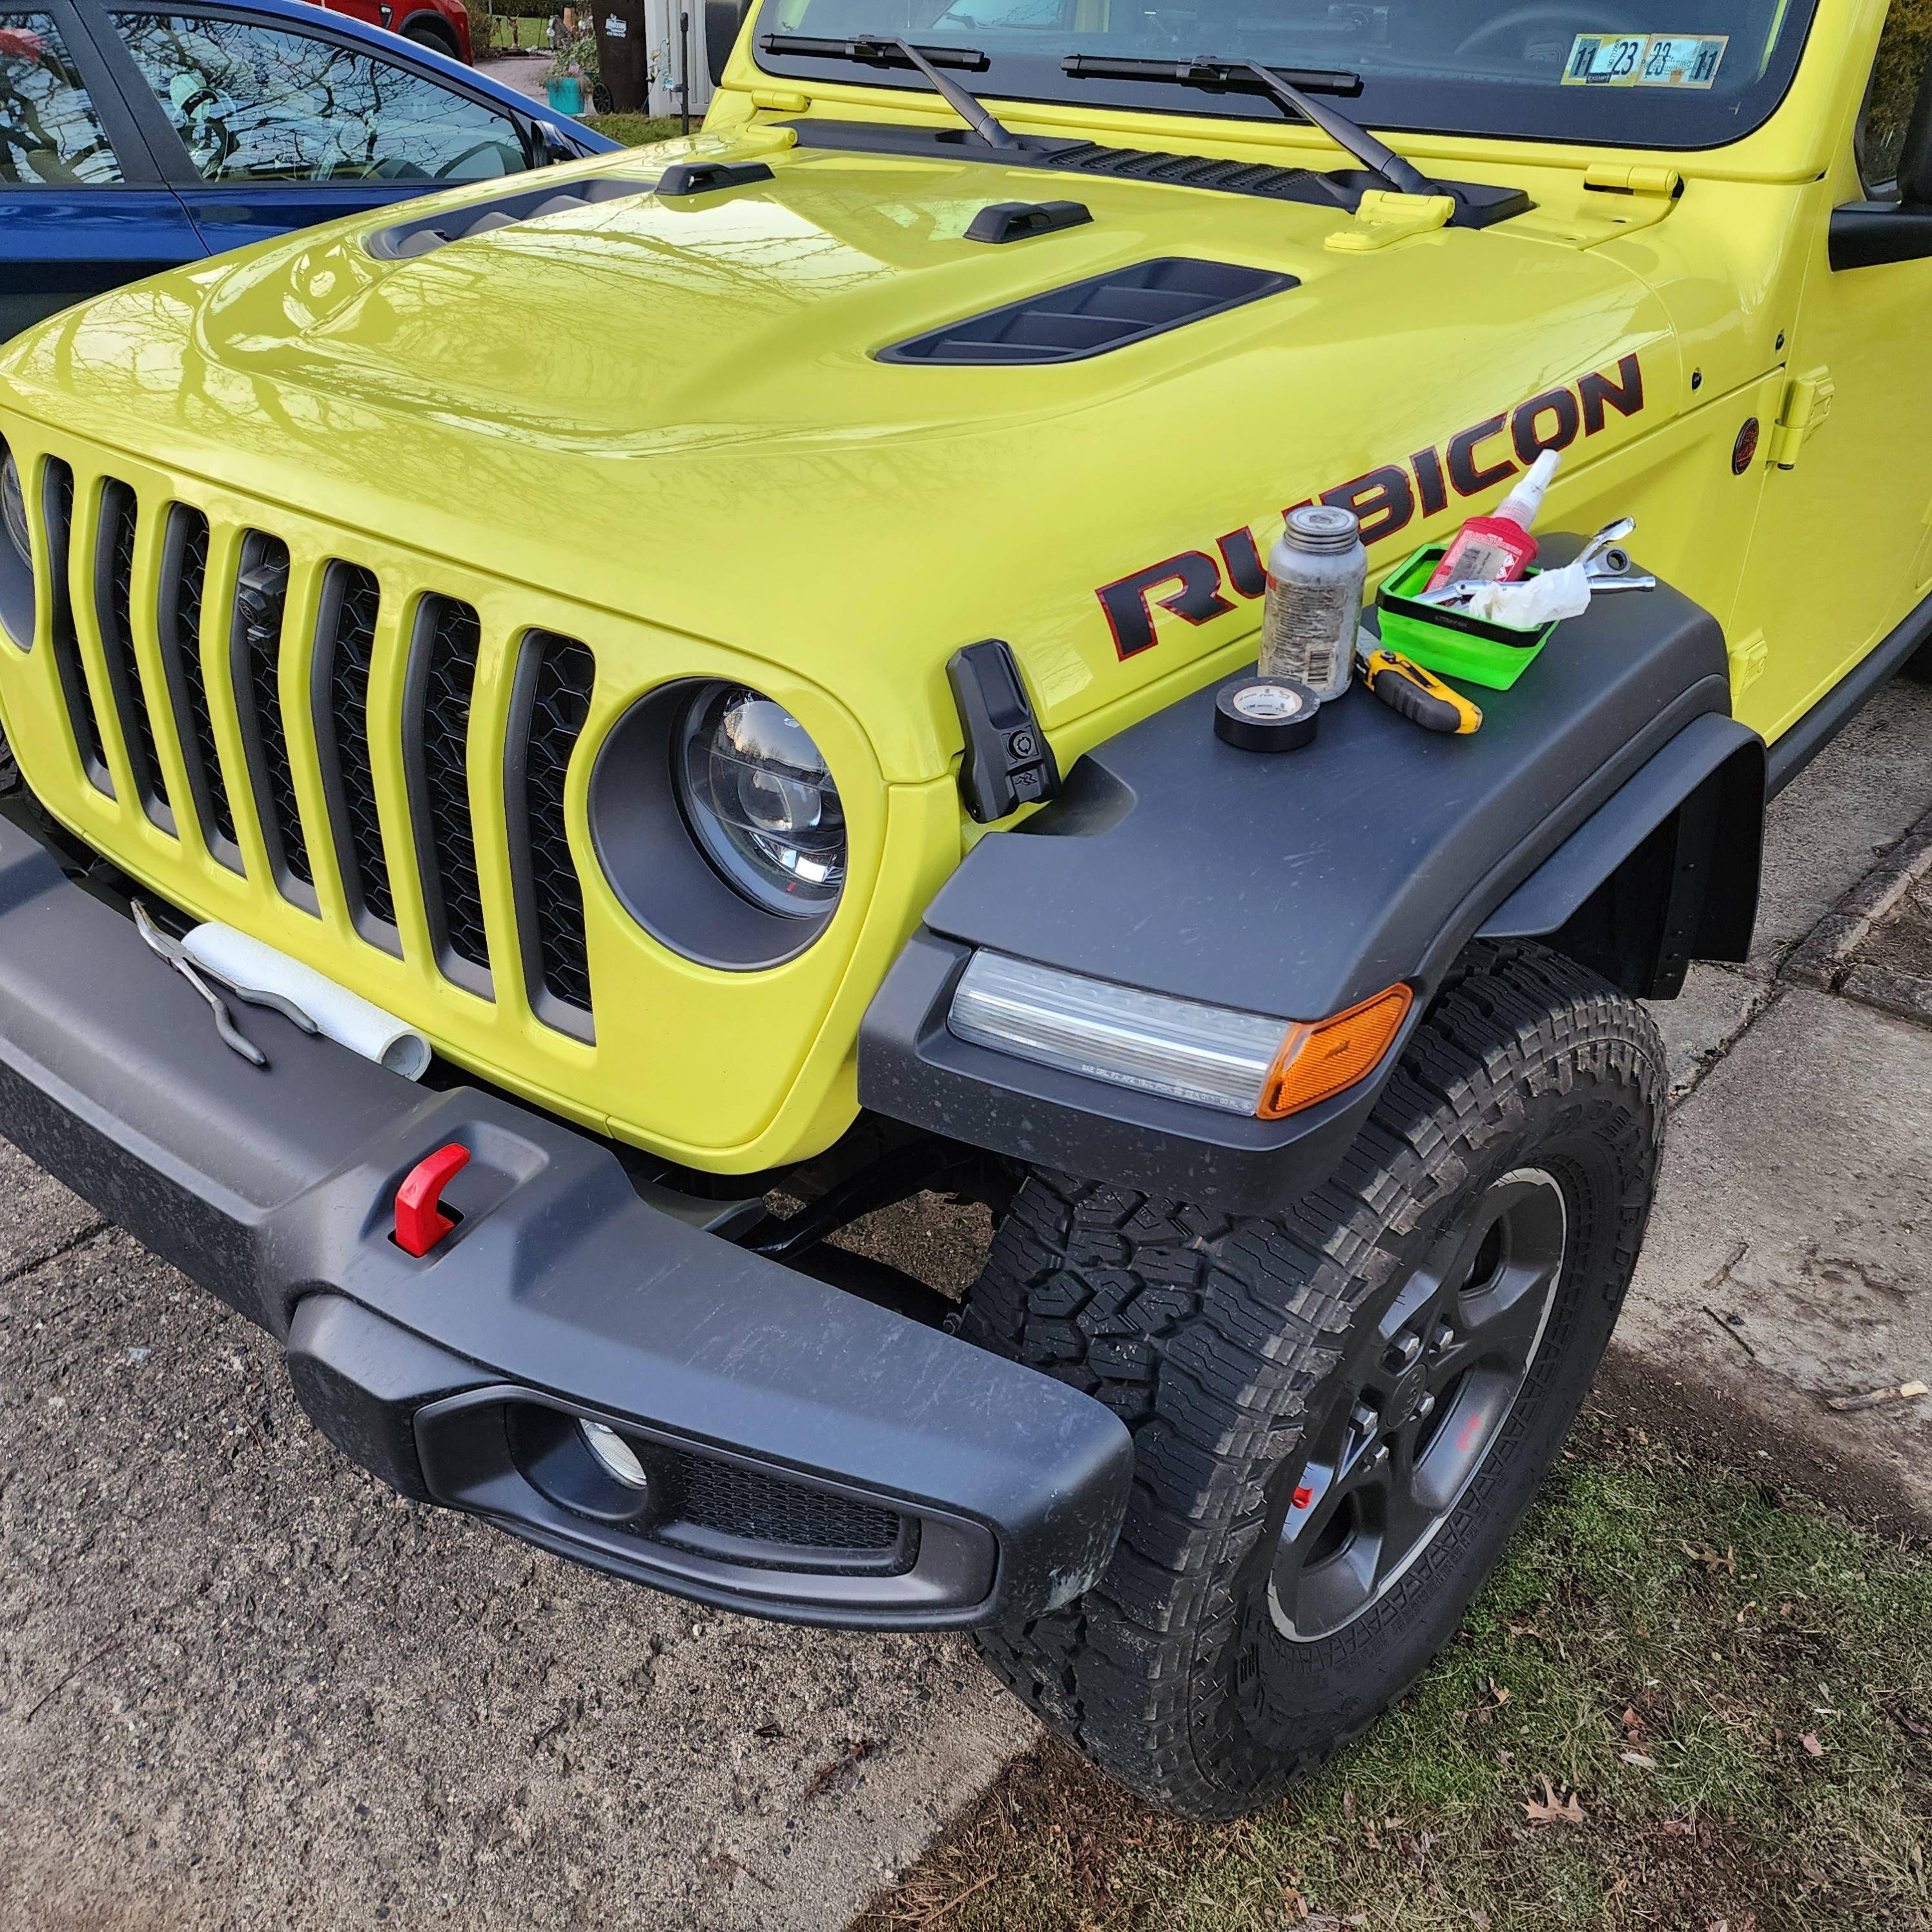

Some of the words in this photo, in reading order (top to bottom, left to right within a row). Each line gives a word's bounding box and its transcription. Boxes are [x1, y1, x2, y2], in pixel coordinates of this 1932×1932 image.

[1574, 47, 1597, 76] 11
[1612, 42, 1639, 76] 23
[1645, 42, 1672, 76] 23
[1694, 50, 1718, 81] 11
